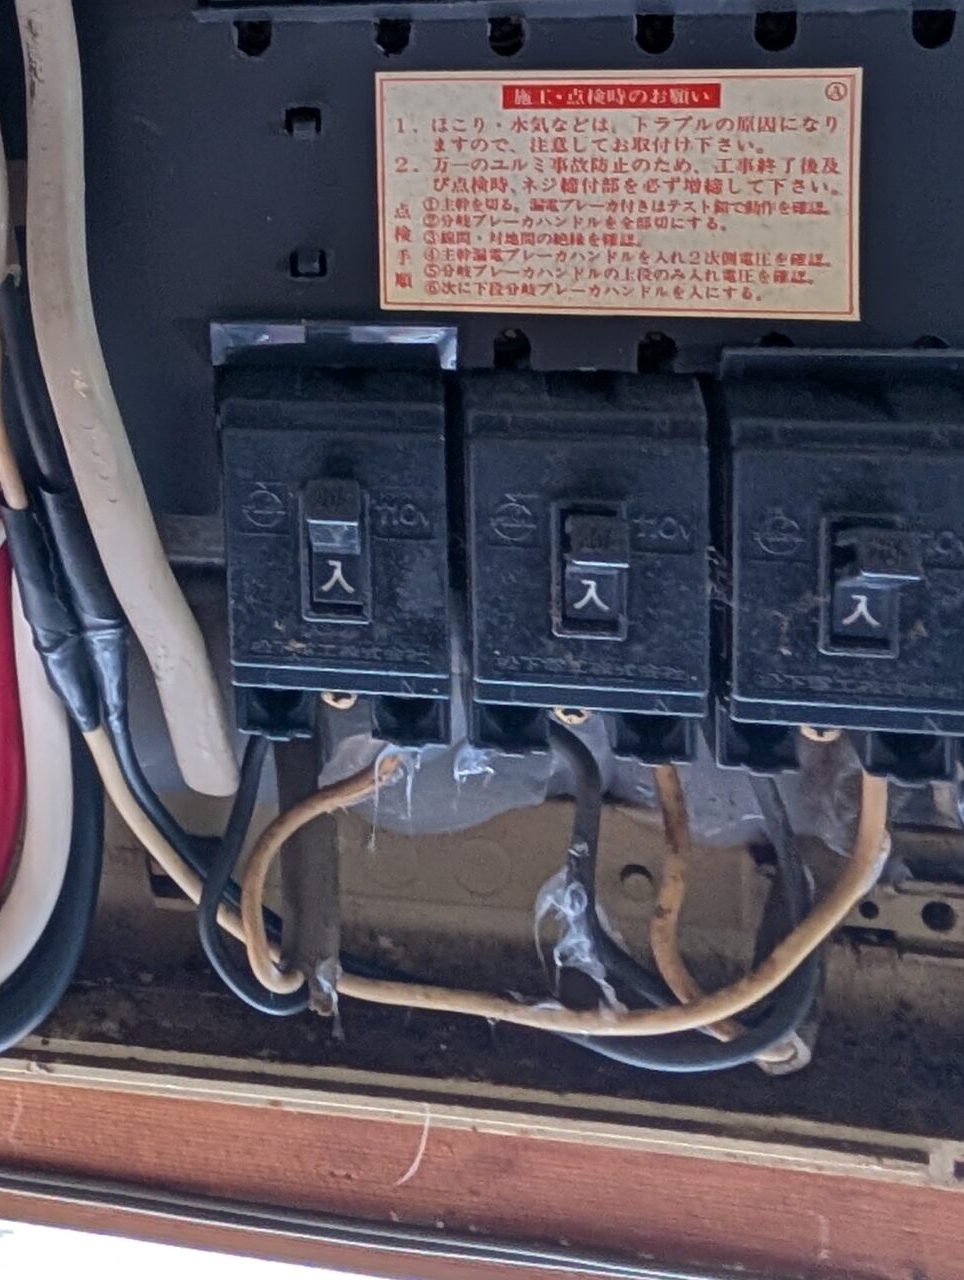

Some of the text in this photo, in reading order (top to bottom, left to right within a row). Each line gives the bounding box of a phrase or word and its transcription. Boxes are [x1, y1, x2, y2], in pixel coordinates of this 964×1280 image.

[320, 559, 356, 595] 入
[573, 579, 611, 613] 入
[841, 594, 882, 629] 入
